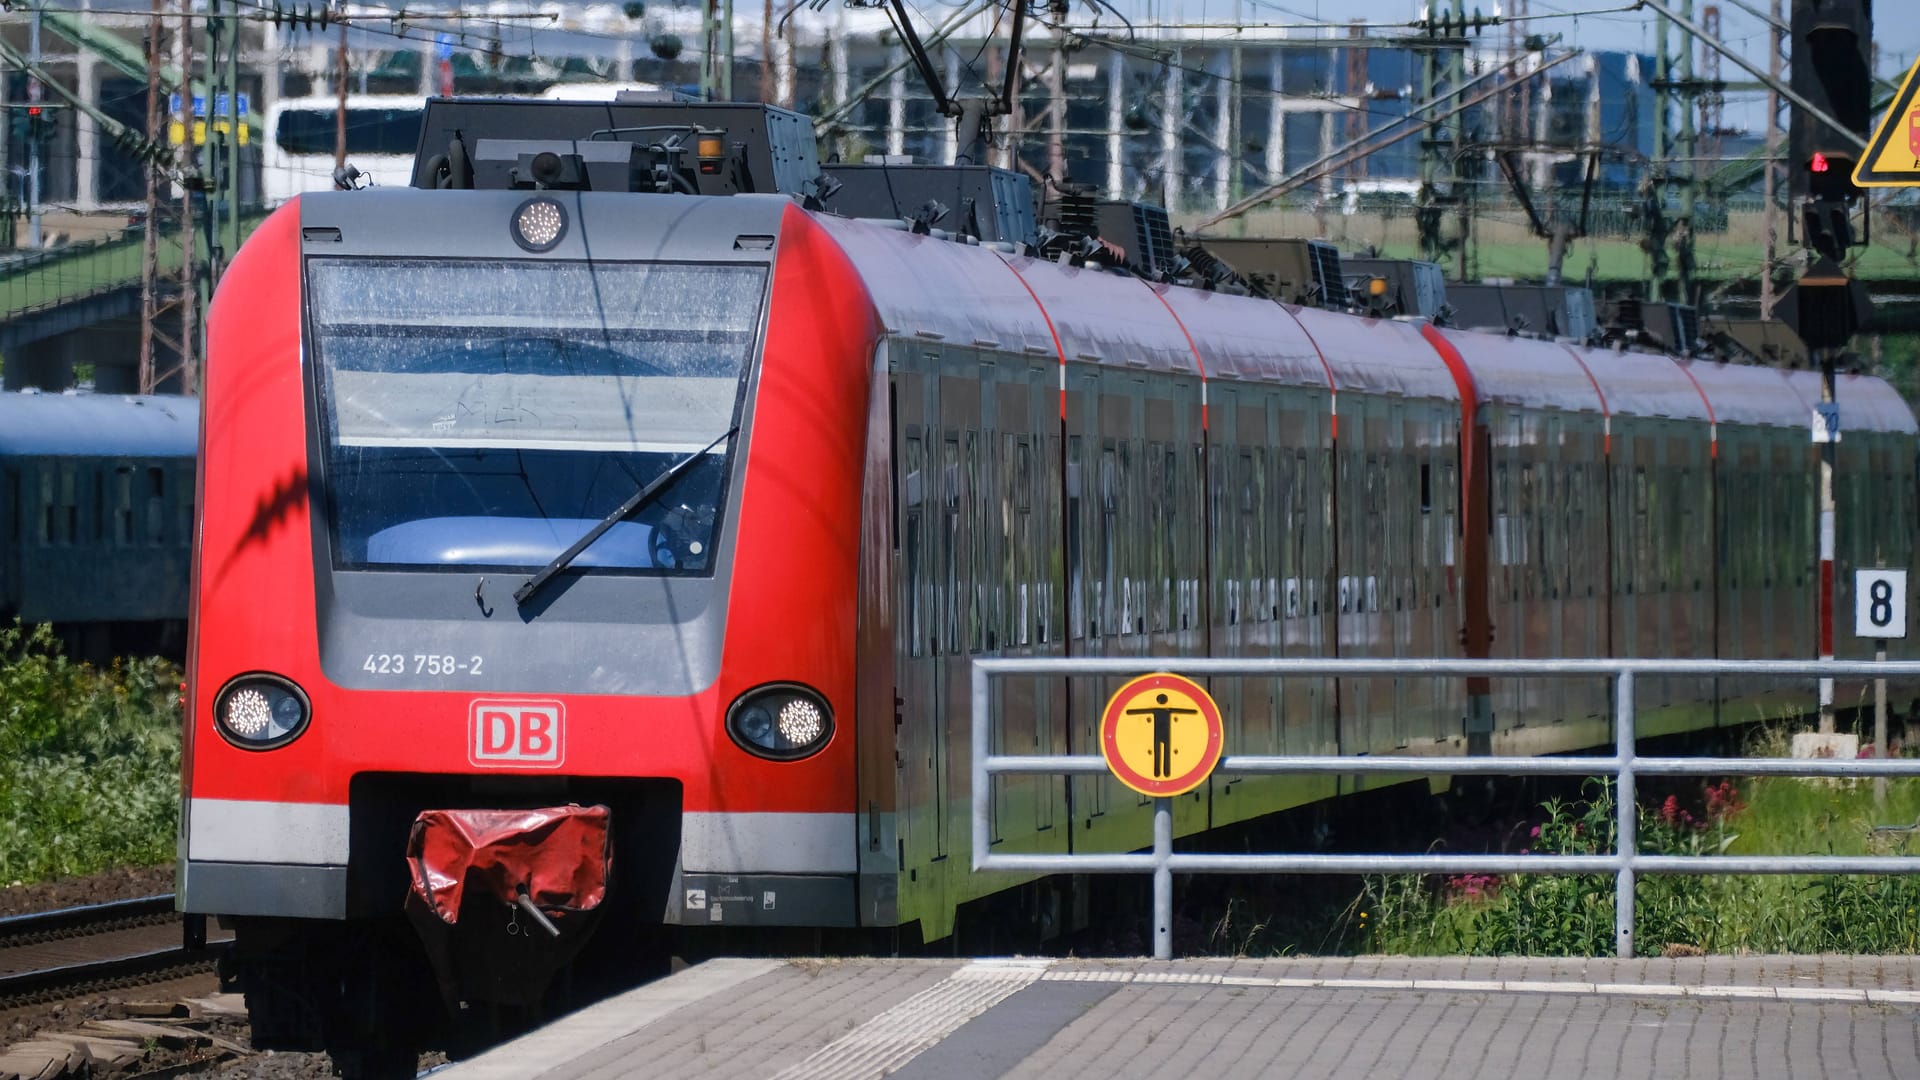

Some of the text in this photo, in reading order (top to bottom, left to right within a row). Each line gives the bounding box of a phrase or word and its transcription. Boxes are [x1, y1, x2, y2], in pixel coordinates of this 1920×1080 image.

[1870, 579, 1892, 627] 8
[363, 654, 483, 675] 423 758-2
[481, 711, 553, 755] DB
